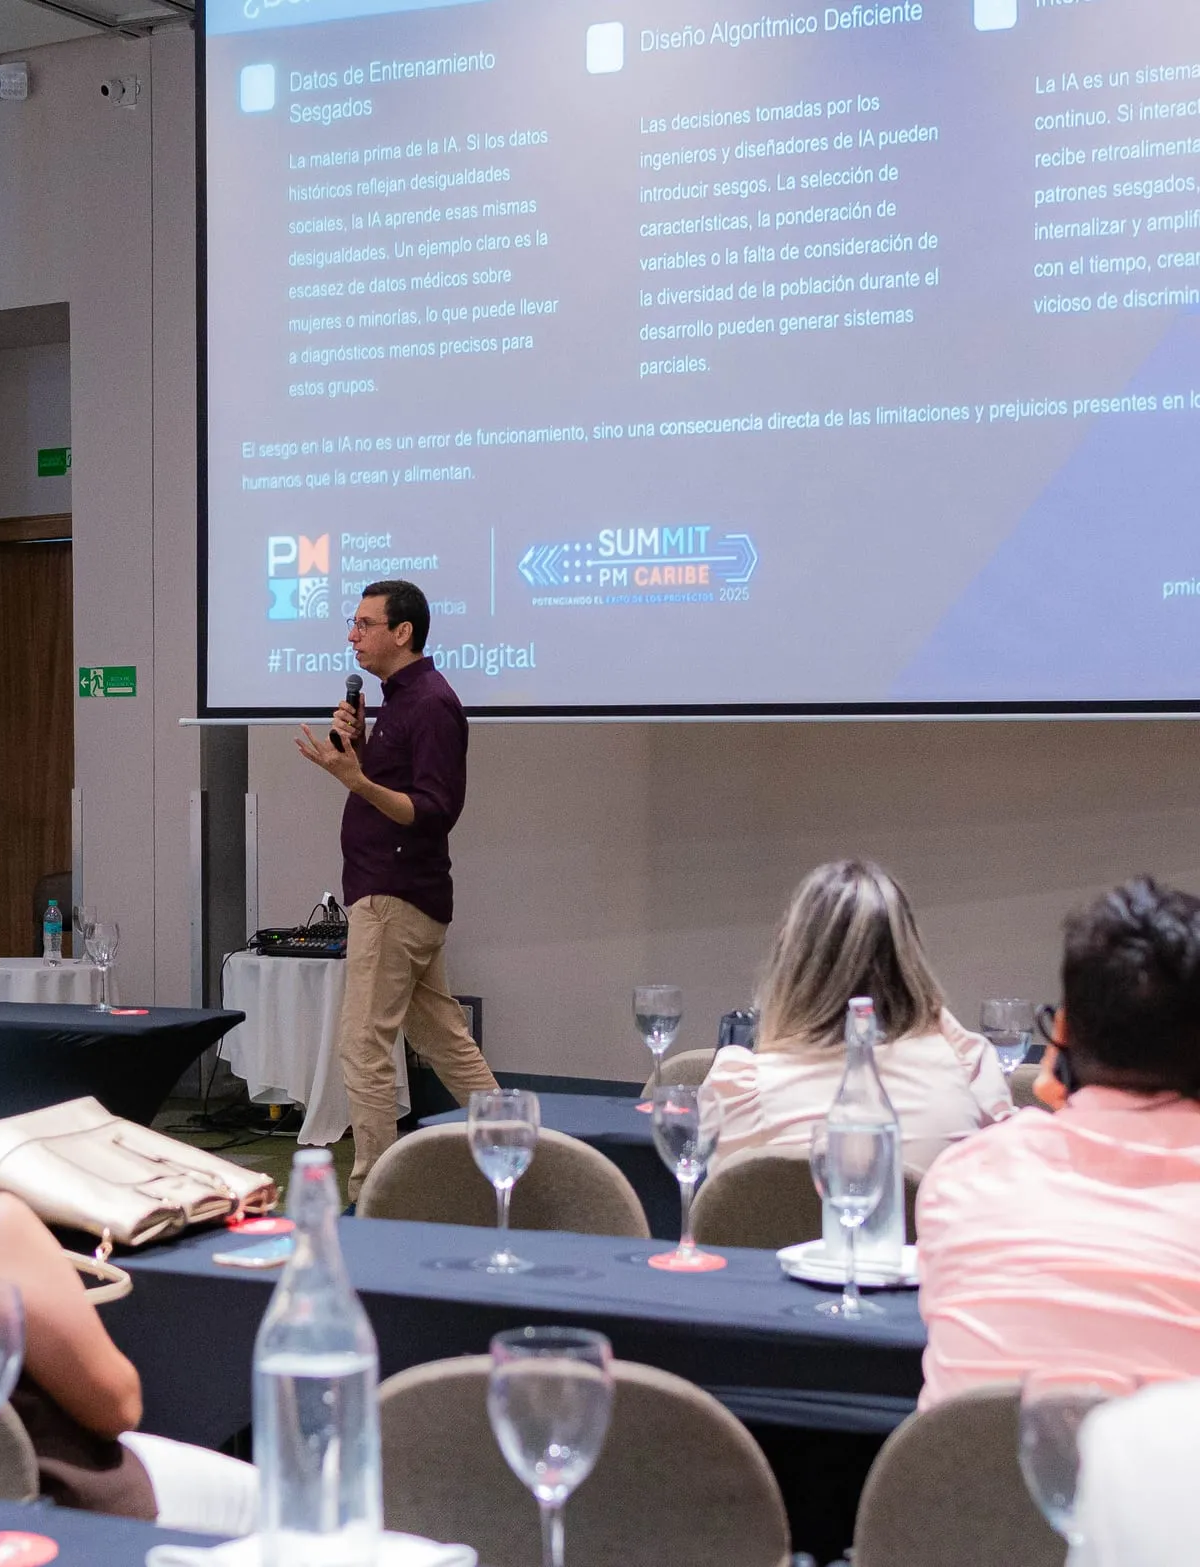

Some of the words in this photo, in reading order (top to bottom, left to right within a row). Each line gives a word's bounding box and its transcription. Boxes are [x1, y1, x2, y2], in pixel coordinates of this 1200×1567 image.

[641, 25, 705, 51] Diseño
[709, 13, 818, 47] Algorítmico
[824, 0, 923, 31] Deficiente
[290, 70, 338, 92] Datos
[343, 65, 364, 85] de
[369, 50, 495, 82] Entrenamiento
[289, 96, 372, 126] Sesgados
[640, 116, 667, 134] Las
[671, 109, 751, 130] decisiones
[755, 99, 822, 122] tomadas
[827, 98, 853, 119] por
[857, 93, 880, 112] los
[640, 147, 717, 171] ingenieros
[721, 146, 730, 164] y
[734, 135, 829, 159] diseñadores
[833, 131, 853, 150] de
[858, 128, 875, 148] IA
[878, 123, 938, 150] pueden
[288, 183, 352, 201] históricos
[356, 176, 406, 197] reflejan
[410, 165, 510, 191] desigualdades
[640, 180, 709, 203] introducir
[713, 178, 771, 199] sesgos.
[777, 173, 796, 191] La
[800, 165, 873, 188] selección
[878, 163, 898, 181] de
[288, 215, 347, 234] sociales,
[351, 213, 363, 230] la
[368, 210, 382, 228] IA
[384, 204, 441, 230] aprende
[445, 205, 478, 220] esas
[482, 199, 536, 217] mismas
[639, 213, 752, 237] características,
[757, 210, 771, 227] la
[775, 200, 872, 230] ponderación
[876, 199, 896, 218] de
[288, 244, 390, 268] desigualdades.
[394, 241, 414, 258] Un
[417, 236, 472, 260] ejemplo
[475, 233, 511, 251] claro
[514, 233, 532, 248] es
[535, 228, 548, 246] la
[639, 250, 706, 271] variables
[710, 252, 721, 266] o
[725, 247, 738, 264] la
[743, 244, 775, 263] falta
[779, 242, 799, 260] de
[803, 232, 913, 259] consideración
[917, 231, 938, 250] de
[288, 282, 344, 299] escasez
[347, 278, 365, 295] de
[368, 276, 407, 293] datos
[410, 271, 468, 290] médicos
[472, 266, 512, 285] sobre
[639, 289, 652, 306] la
[656, 283, 733, 305] diversidad
[738, 280, 757, 299] de
[762, 280, 775, 297] la
[780, 274, 854, 300] población
[859, 270, 920, 290] durante
[924, 267, 939, 286] el
[639, 319, 713, 340] desarrollo
[717, 315, 774, 339] pueden
[778, 313, 840, 336] generar
[843, 308, 914, 327] sistemas
[288, 351, 297, 364] a
[300, 344, 384, 366] diagnósticos
[389, 342, 436, 358] menos
[439, 335, 498, 359] precisos
[502, 335, 534, 355] para
[639, 354, 710, 379] parciales.
[288, 381, 324, 397] estos
[327, 378, 378, 398] grupos.
[242, 474, 303, 490] humanos
[305, 472, 330, 489] que
[334, 468, 346, 486] la
[349, 469, 388, 484] crean
[391, 469, 401, 487] y
[404, 464, 475, 482] alimentan.
[341, 531, 392, 553] Project
[598, 526, 710, 557] SUMMIT
[341, 553, 438, 575] Management
[599, 567, 627, 587] PM
[634, 563, 710, 586] CARIBE
[719, 585, 750, 602] 2025
